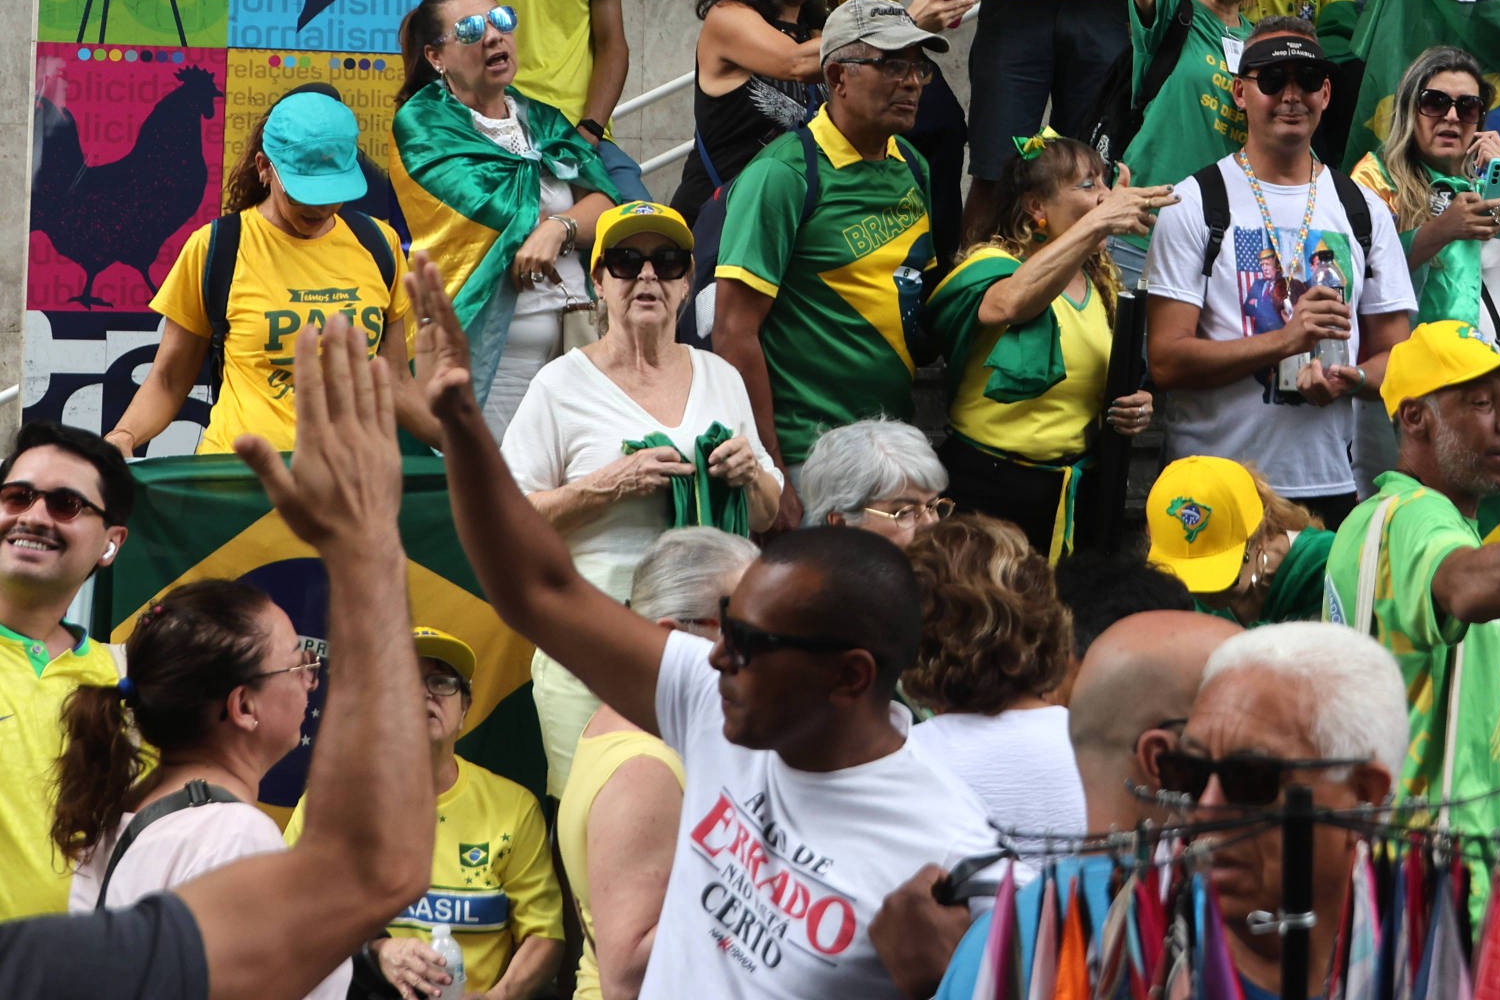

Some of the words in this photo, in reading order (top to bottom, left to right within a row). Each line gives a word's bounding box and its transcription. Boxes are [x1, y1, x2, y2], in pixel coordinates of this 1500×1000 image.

[690, 793, 856, 956] ERRADO
[793, 844, 834, 877] DE
[408, 896, 479, 922] ASIL
[701, 881, 782, 969] CERTO
